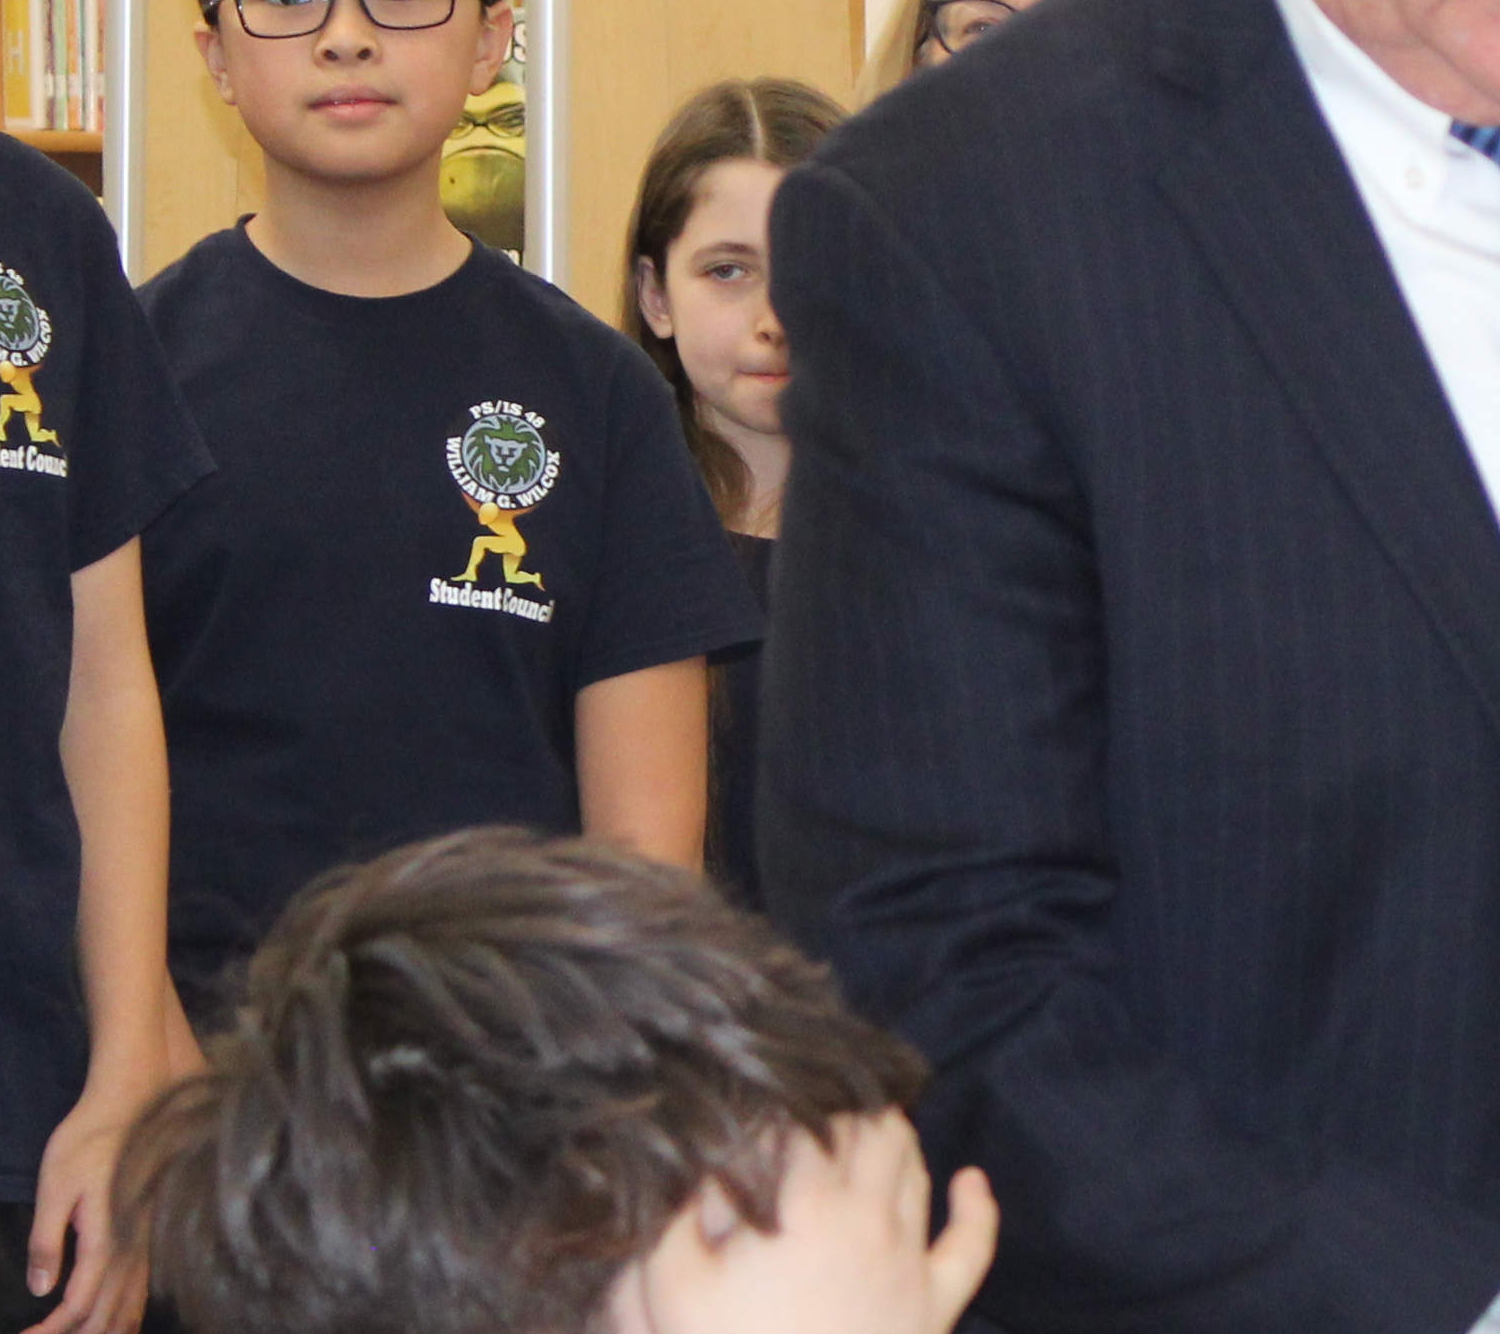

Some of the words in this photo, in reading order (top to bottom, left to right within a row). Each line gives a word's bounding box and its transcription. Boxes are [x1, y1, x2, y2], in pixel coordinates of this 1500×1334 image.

[11, 352, 28, 366] G.
[469, 399, 523, 419] PS/IS
[524, 410, 546, 429] 48
[26, 445, 68, 478] Counc
[446, 436, 494, 504] WILLIAM
[497, 495, 516, 508] G.
[516, 450, 561, 507] WILCOX
[429, 577, 501, 611] Student
